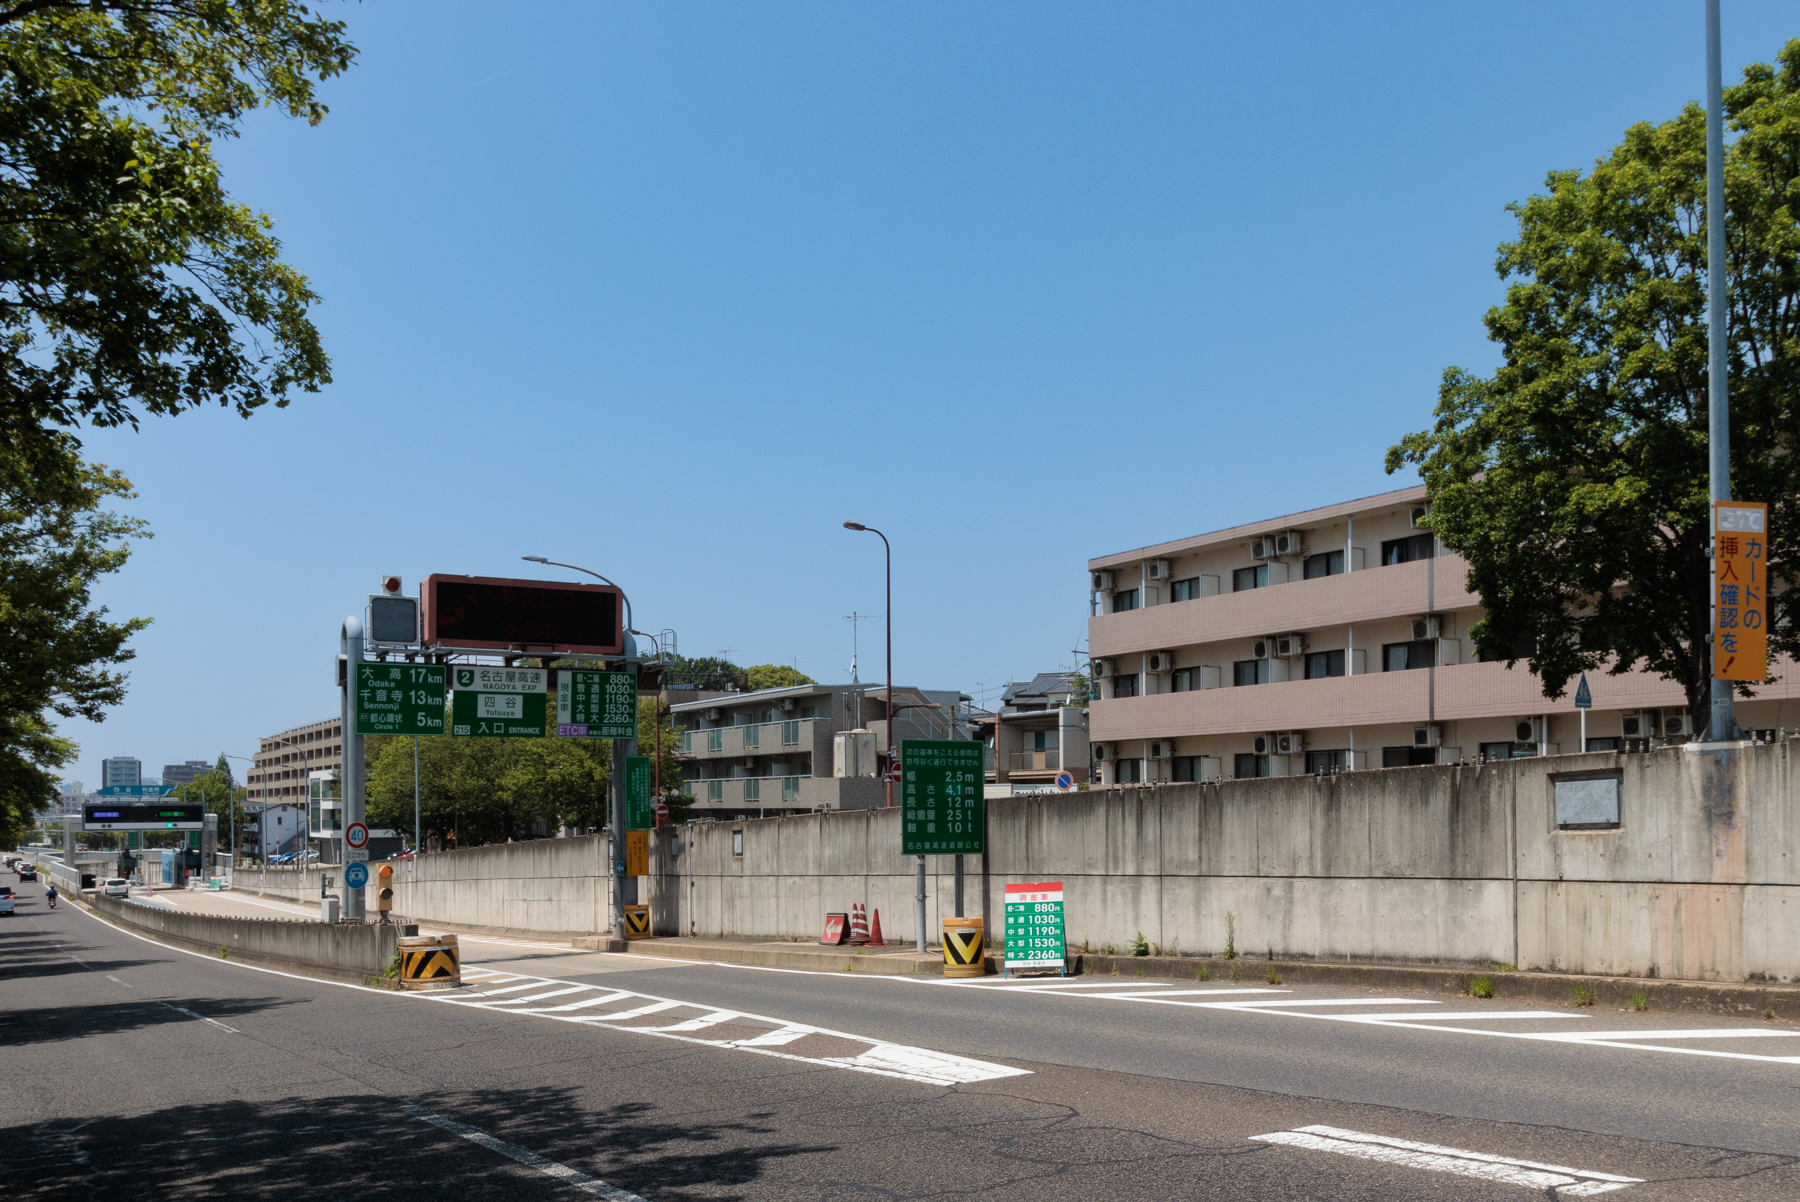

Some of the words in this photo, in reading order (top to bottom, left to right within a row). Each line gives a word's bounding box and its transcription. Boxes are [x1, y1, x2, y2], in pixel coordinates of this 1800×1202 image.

[1743, 538, 1762, 629] カードの
[361, 667, 401, 680] 大高
[461, 671, 470, 683] 2
[479, 670, 541, 684] 名古屋高速
[482, 683, 516, 691] NAGOYA
[360, 689, 403, 702] 千音寺
[560, 683, 569, 712] 現金車
[363, 702, 400, 711] Sennonji
[484, 696, 516, 709] 四谷
[370, 713, 403, 723] 都心環状
[485, 709, 515, 717] Yotsuya
[455, 726, 469, 734] 215
[478, 722, 504, 734] 入口
[559, 726, 587, 736] ETC車
[906, 771, 916, 781] 幅
[906, 784, 935, 795] 高さ
[906, 796, 936, 807] 長さ
[906, 809, 936, 820] 総重量
[350, 829, 364, 841] 40
[1019, 893, 1048, 901] 現金車
